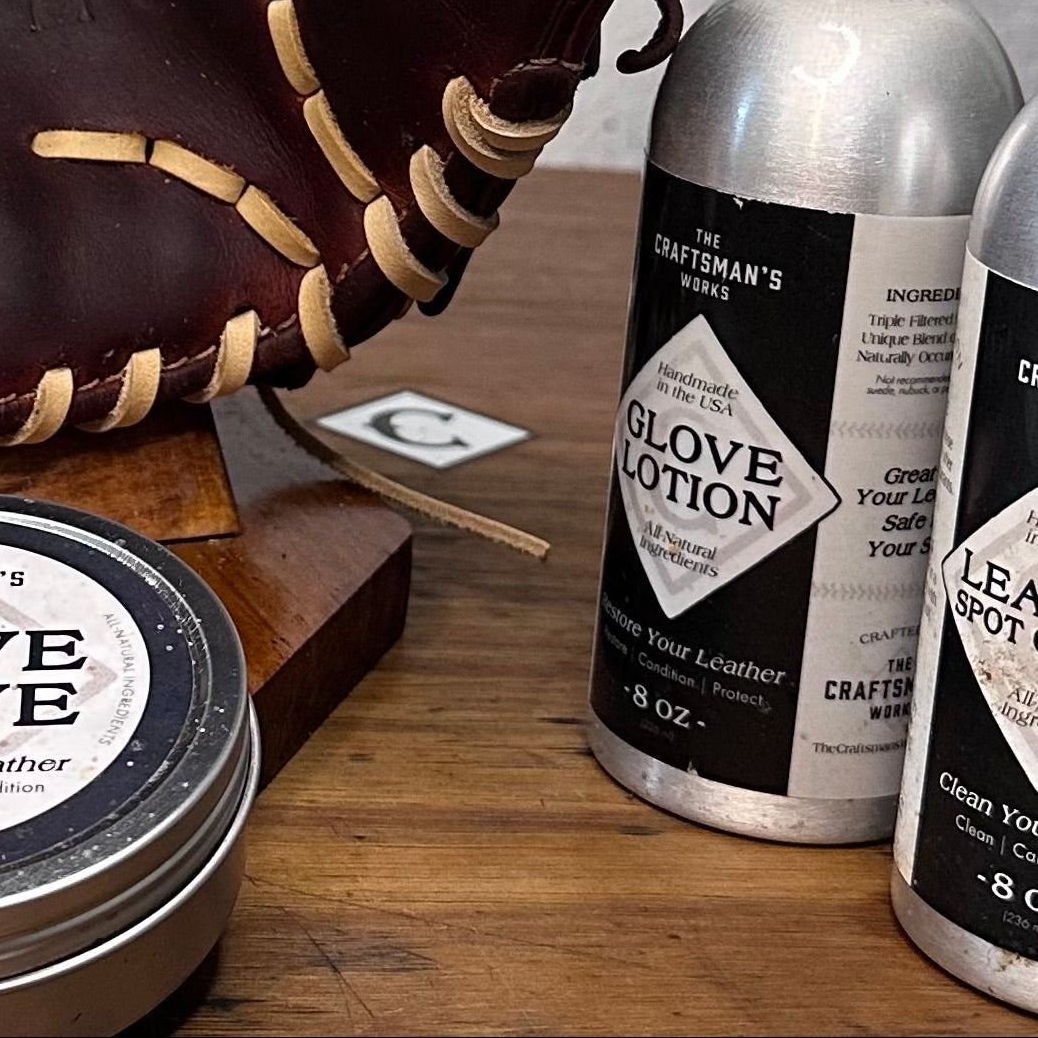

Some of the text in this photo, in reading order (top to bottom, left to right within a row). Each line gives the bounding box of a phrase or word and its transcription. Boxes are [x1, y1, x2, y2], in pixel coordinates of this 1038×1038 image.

[696, 228, 721, 250] THE
[654, 233, 783, 291] CRAFTSMAN'S
[680, 271, 730, 301] WORKS
[857, 349, 914, 366] Naturally
[861, 332, 909, 348] Unique
[912, 332, 948, 345] Blend
[656, 380, 733, 416] in the USA
[658, 361, 739, 400] Handmade
[364, 408, 469, 448] C
[627, 399, 783, 487] GLOVE
[622, 439, 781, 531] LOTION
[884, 466, 938, 485] Great
[857, 488, 908, 505] Your
[643, 520, 718, 561] All-Natural
[882, 512, 927, 532] Safe
[639, 536, 720, 578] Ingredients
[868, 541, 917, 557] Your
[955, 588, 1024, 645] SPOT
[647, 627, 692, 661] Your
[695, 649, 787, 685] Leather
[888, 656, 913, 673] THE
[98, 613, 135, 747] ALL-NATURAL INGREDIENTS
[638, 652, 764, 706] Condition Protect
[940, 772, 994, 817] Clean
[955, 814, 994, 846] Clean
